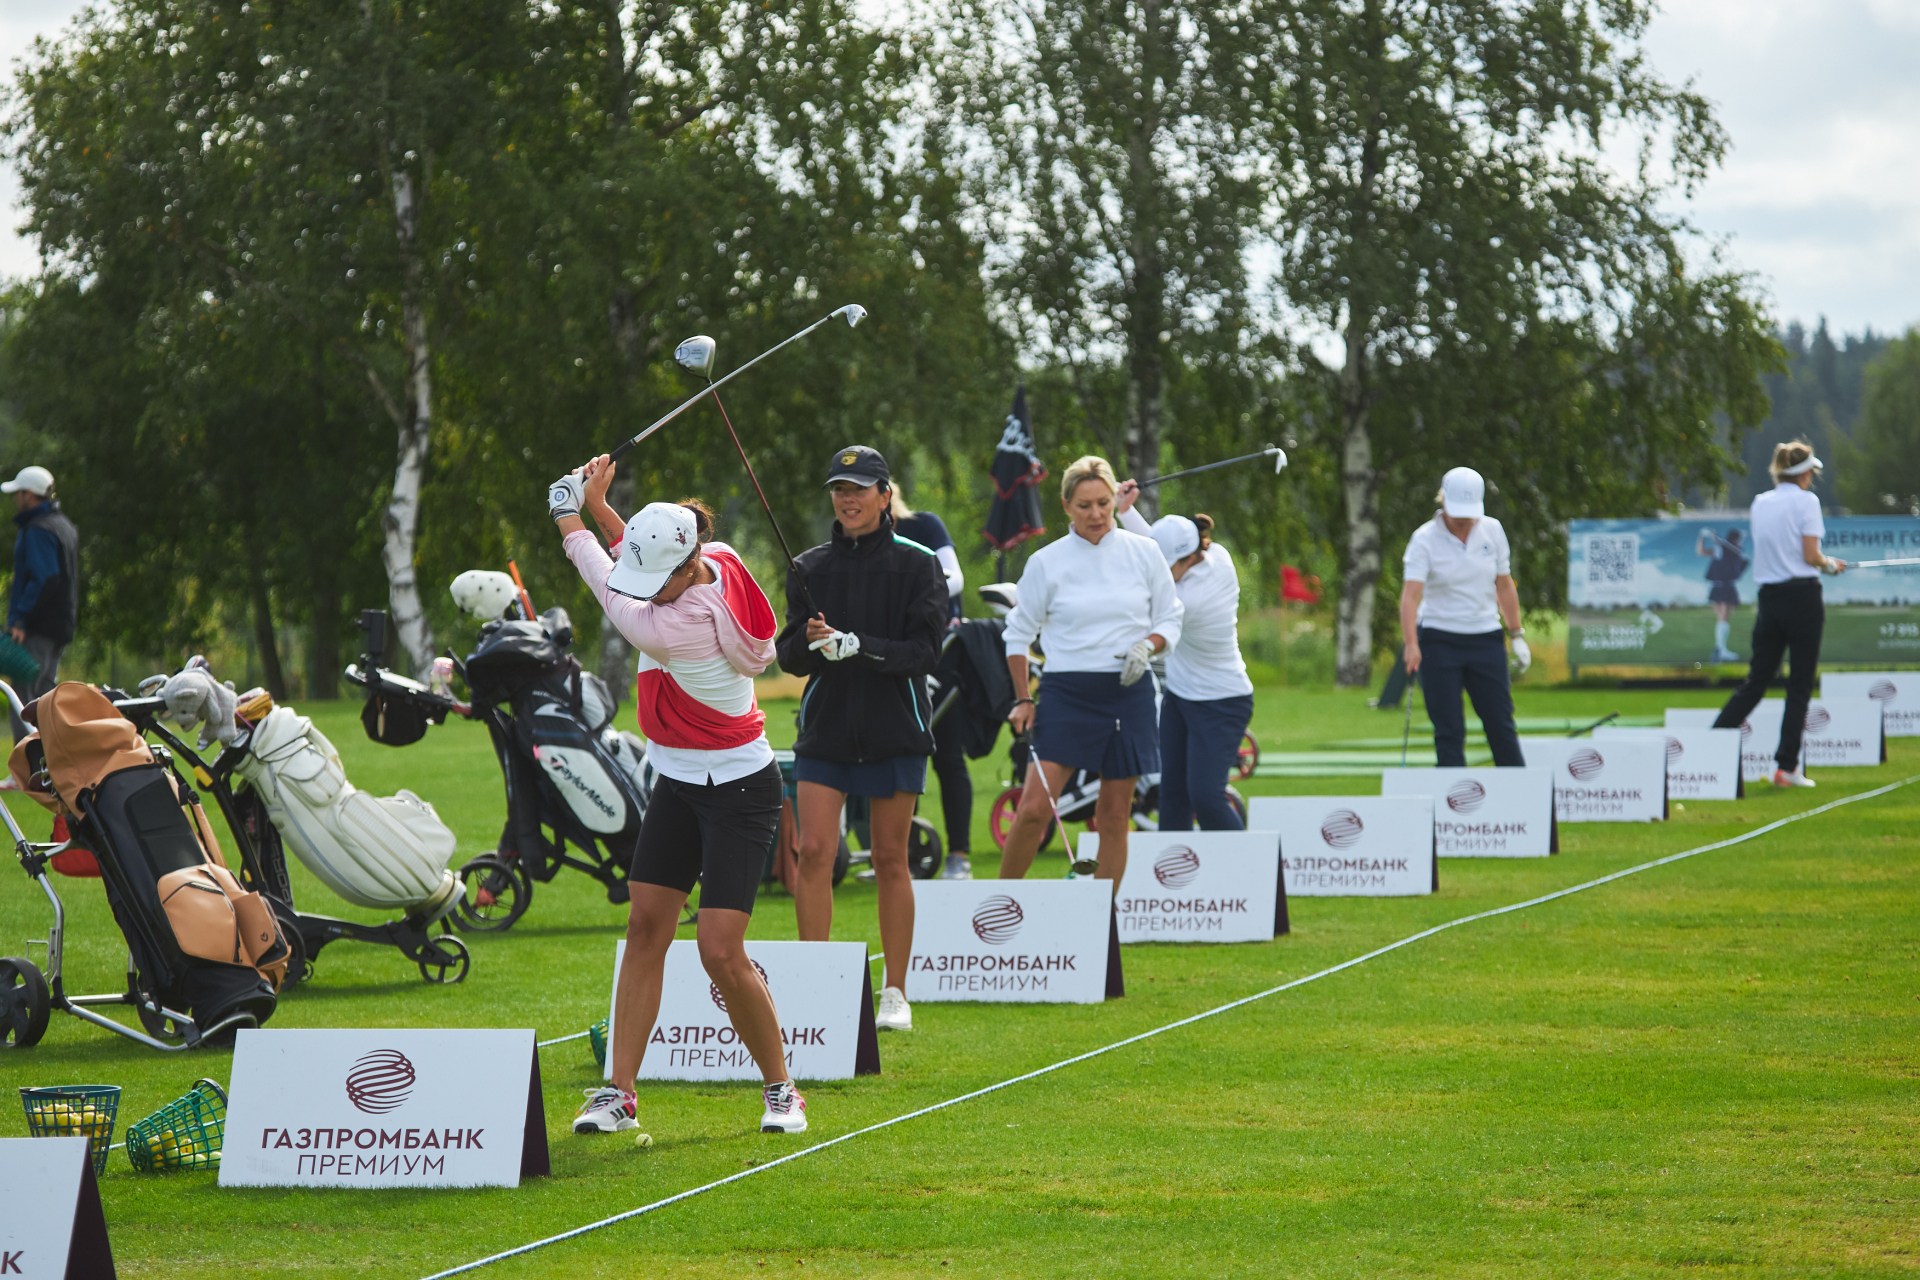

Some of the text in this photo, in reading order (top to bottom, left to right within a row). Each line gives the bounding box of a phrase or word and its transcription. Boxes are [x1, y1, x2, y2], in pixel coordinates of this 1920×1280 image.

[1293, 873, 1386, 888] ПРЕМИУМ
[1123, 916, 1222, 932] ПРЕМИУМ
[912, 955, 1076, 972] ГАЗПРОМБАНК
[939, 975, 1048, 991] ПРЕМИУМ
[262, 1128, 485, 1150] ГАЗПРОМБАНК
[297, 1154, 445, 1176] ПРЕМИУМ
